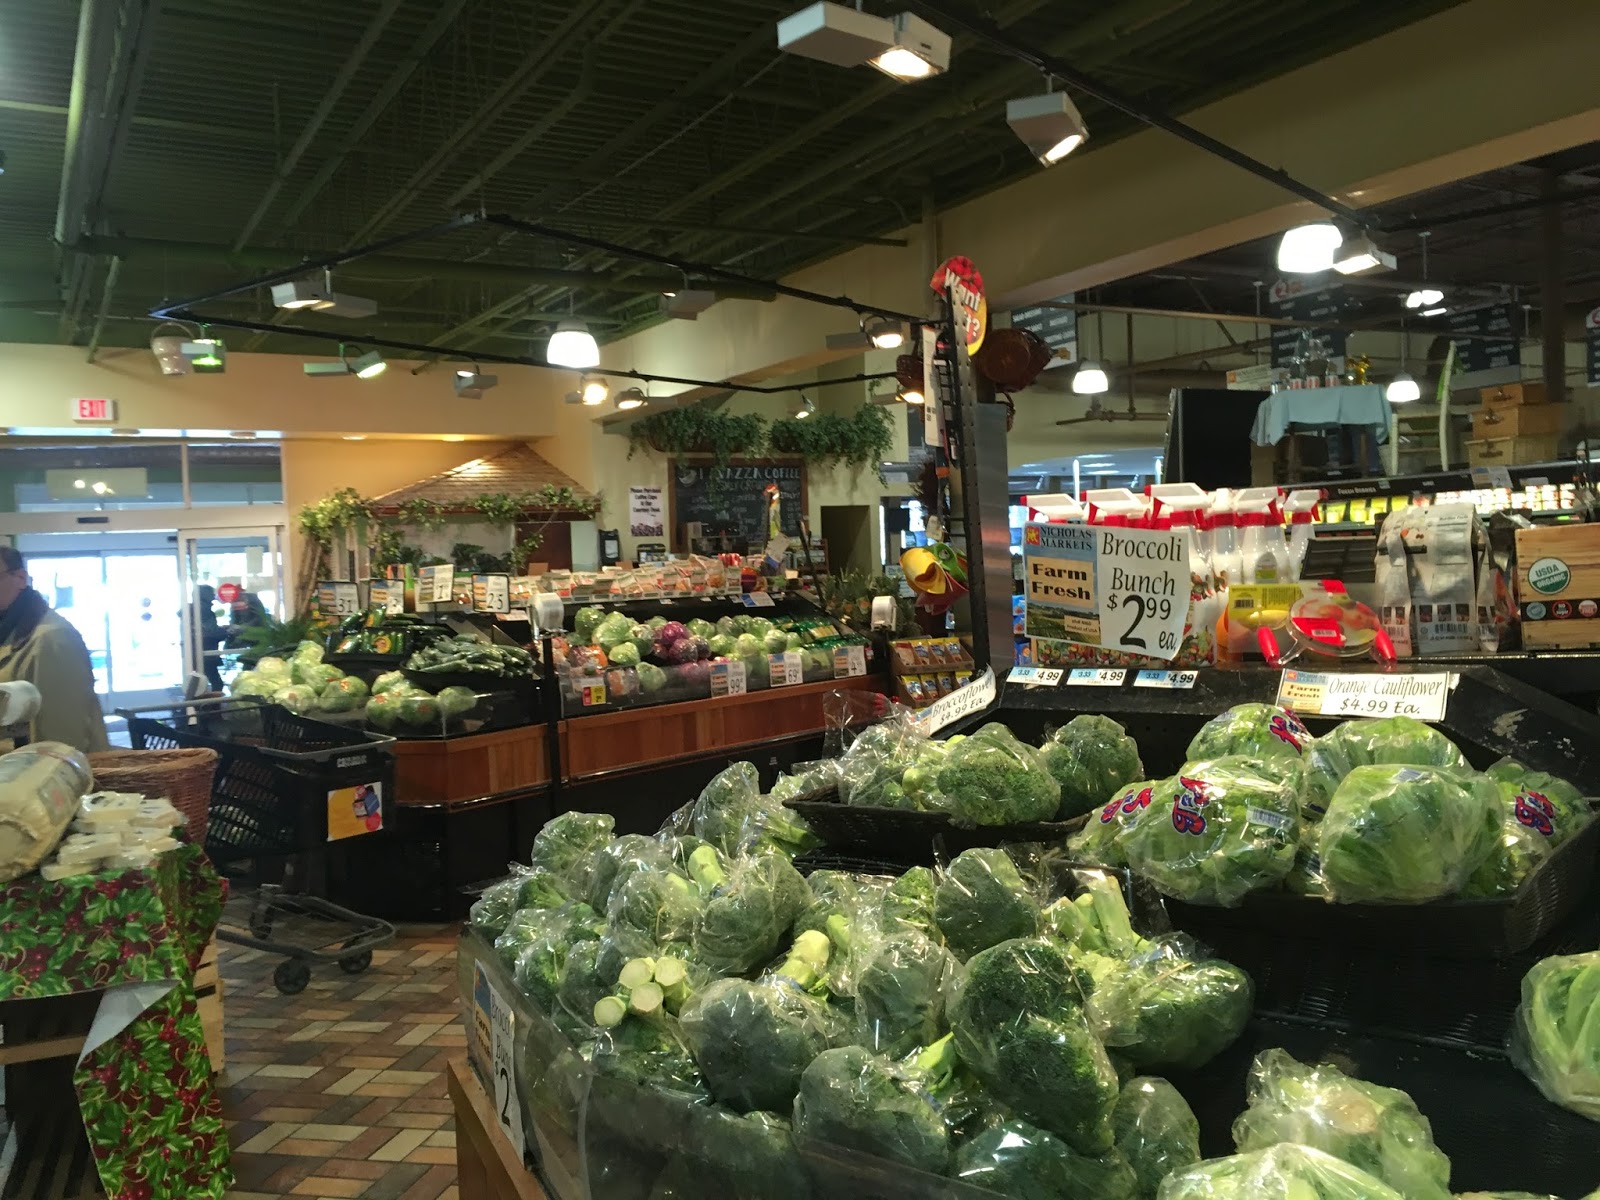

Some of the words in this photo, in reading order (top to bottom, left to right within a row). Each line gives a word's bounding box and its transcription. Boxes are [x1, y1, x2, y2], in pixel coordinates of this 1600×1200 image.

[79, 399, 106, 418] EXIT
[1041, 526, 1092, 539] NICHOLAS
[1041, 538, 1093, 551] MARKETS
[1102, 532, 1182, 561] Broccoli
[1032, 563, 1087, 581] Farm
[1535, 564, 1559, 578] USDA
[1536, 572, 1567, 588] ORGANIC
[1111, 567, 1176, 596] Bunch
[1032, 581, 1091, 601] Fresh
[932, 675, 993, 718] Broccoflower
[1328, 677, 1370, 698] Orange
[1373, 677, 1443, 698] Cauliflower
[1340, 698, 1388, 713] $4.99
[1394, 701, 1420, 714] Ea.
